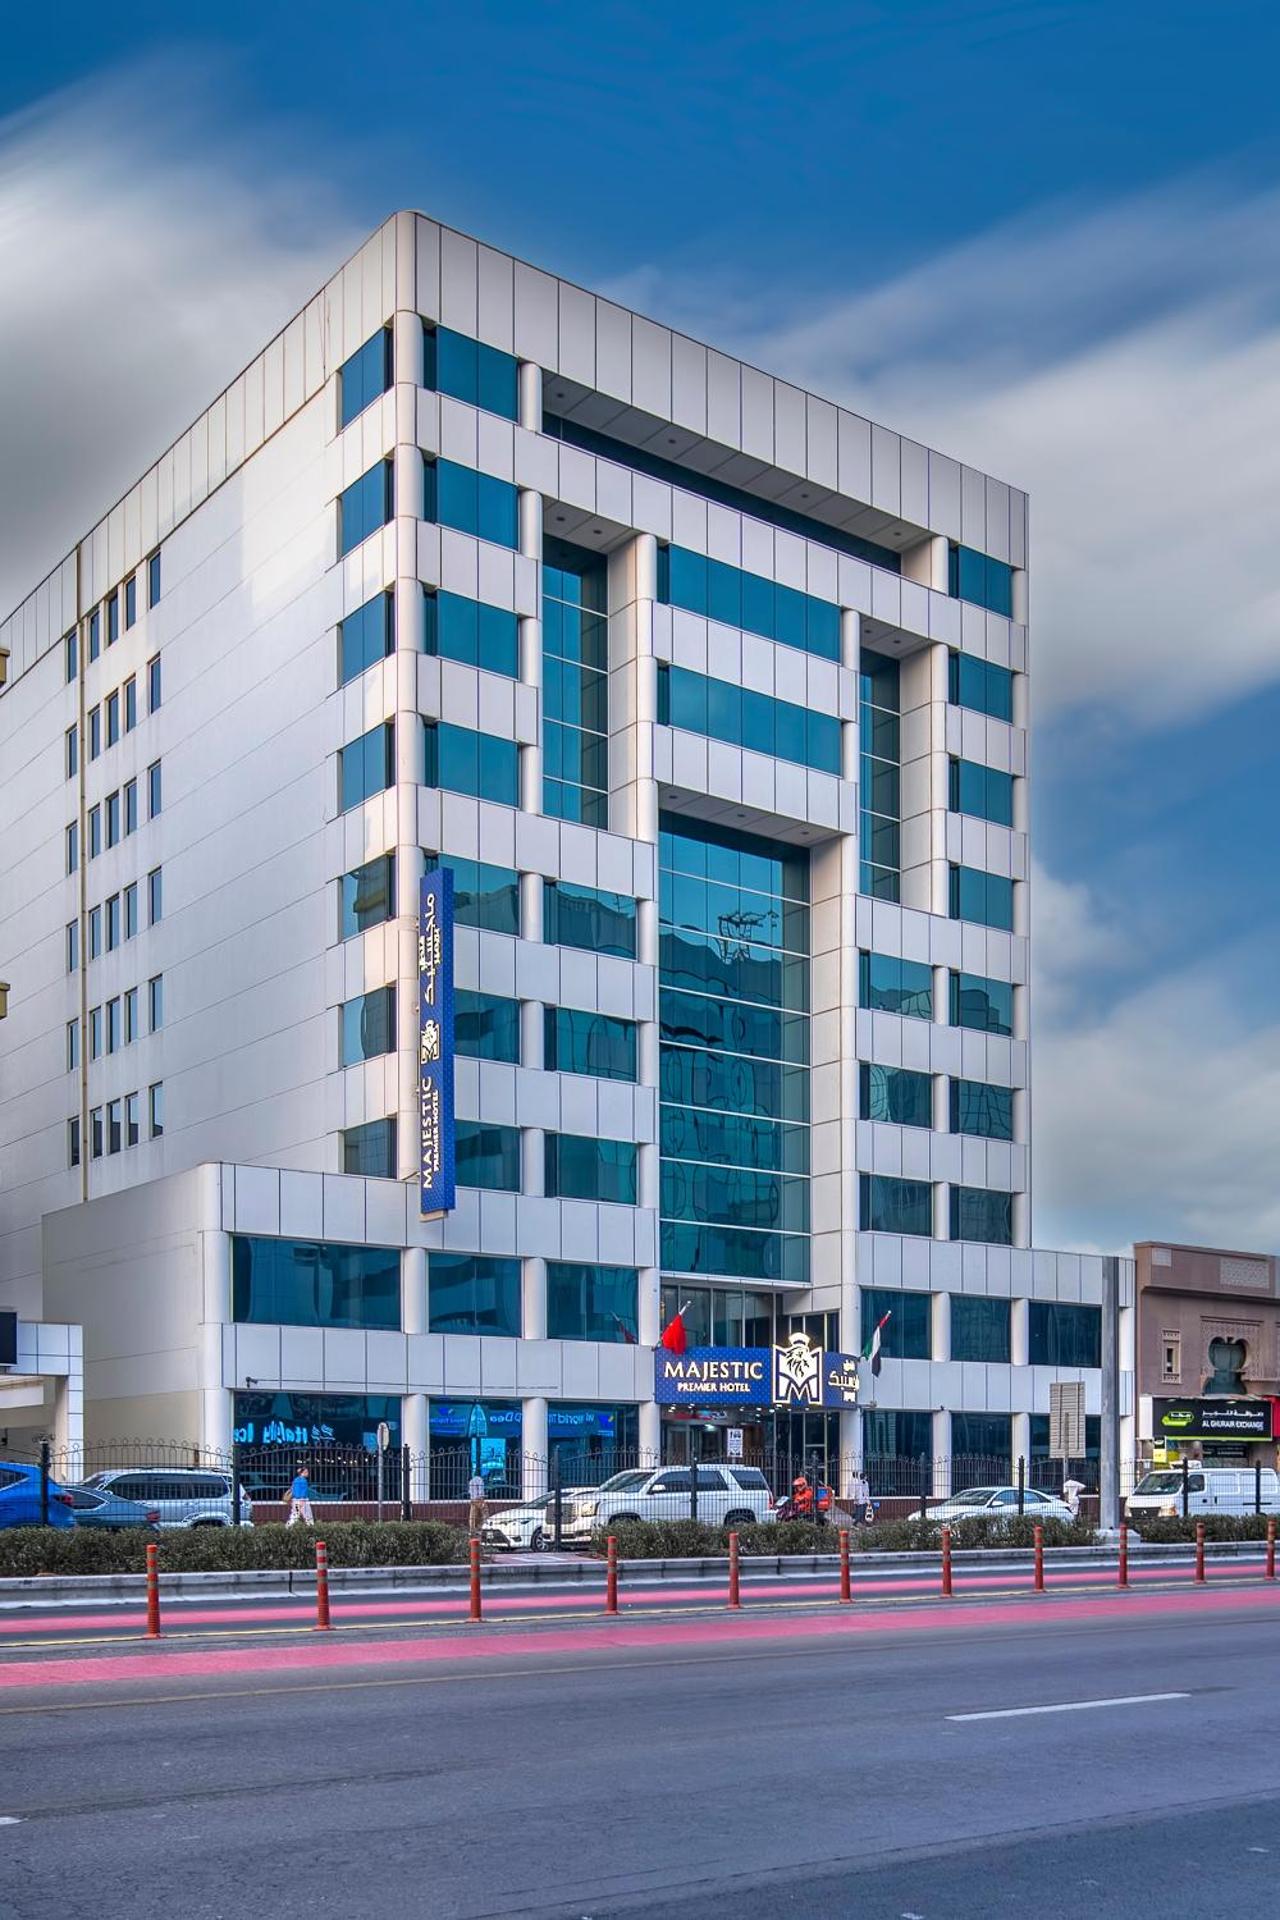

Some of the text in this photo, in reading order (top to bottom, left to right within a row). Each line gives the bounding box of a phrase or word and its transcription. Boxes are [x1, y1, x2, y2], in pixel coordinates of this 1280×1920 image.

[424, 893, 436, 1006] ماجستيك
[422, 1076, 433, 1189] MAJESTIC
[432, 1126, 440, 1172] PREMIER
[664, 1361, 763, 1380] MAJESTIC
[677, 1382, 750, 1392] PREMIER HOTEL
